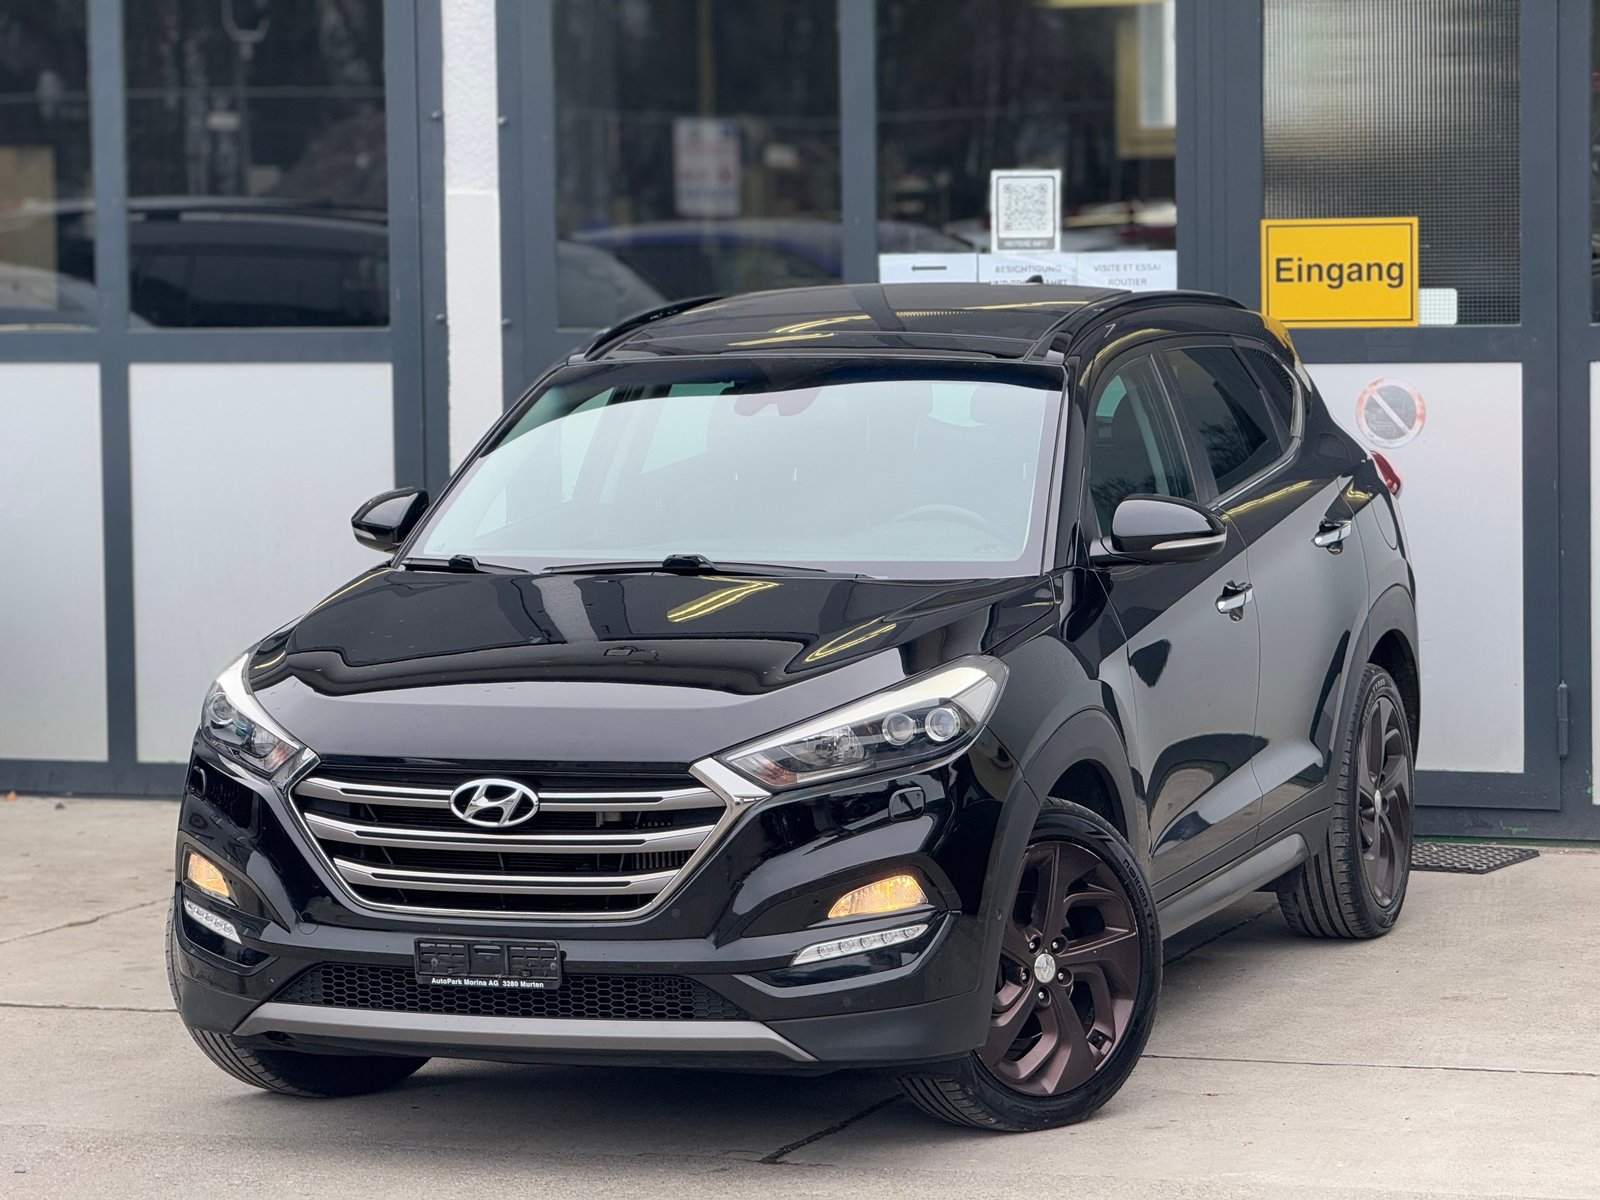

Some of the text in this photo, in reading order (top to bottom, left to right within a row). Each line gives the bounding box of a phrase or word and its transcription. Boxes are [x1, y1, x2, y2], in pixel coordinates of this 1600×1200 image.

[995, 265, 1062, 273] BESICHTIGUNG
[1093, 264, 1162, 272] VISITE ET ESSAI
[1275, 257, 1404, 290] Eingang
[1107, 278, 1148, 286] ROUTIER
[463, 979, 488, 987] Morina
[520, 981, 545, 989] Murten
